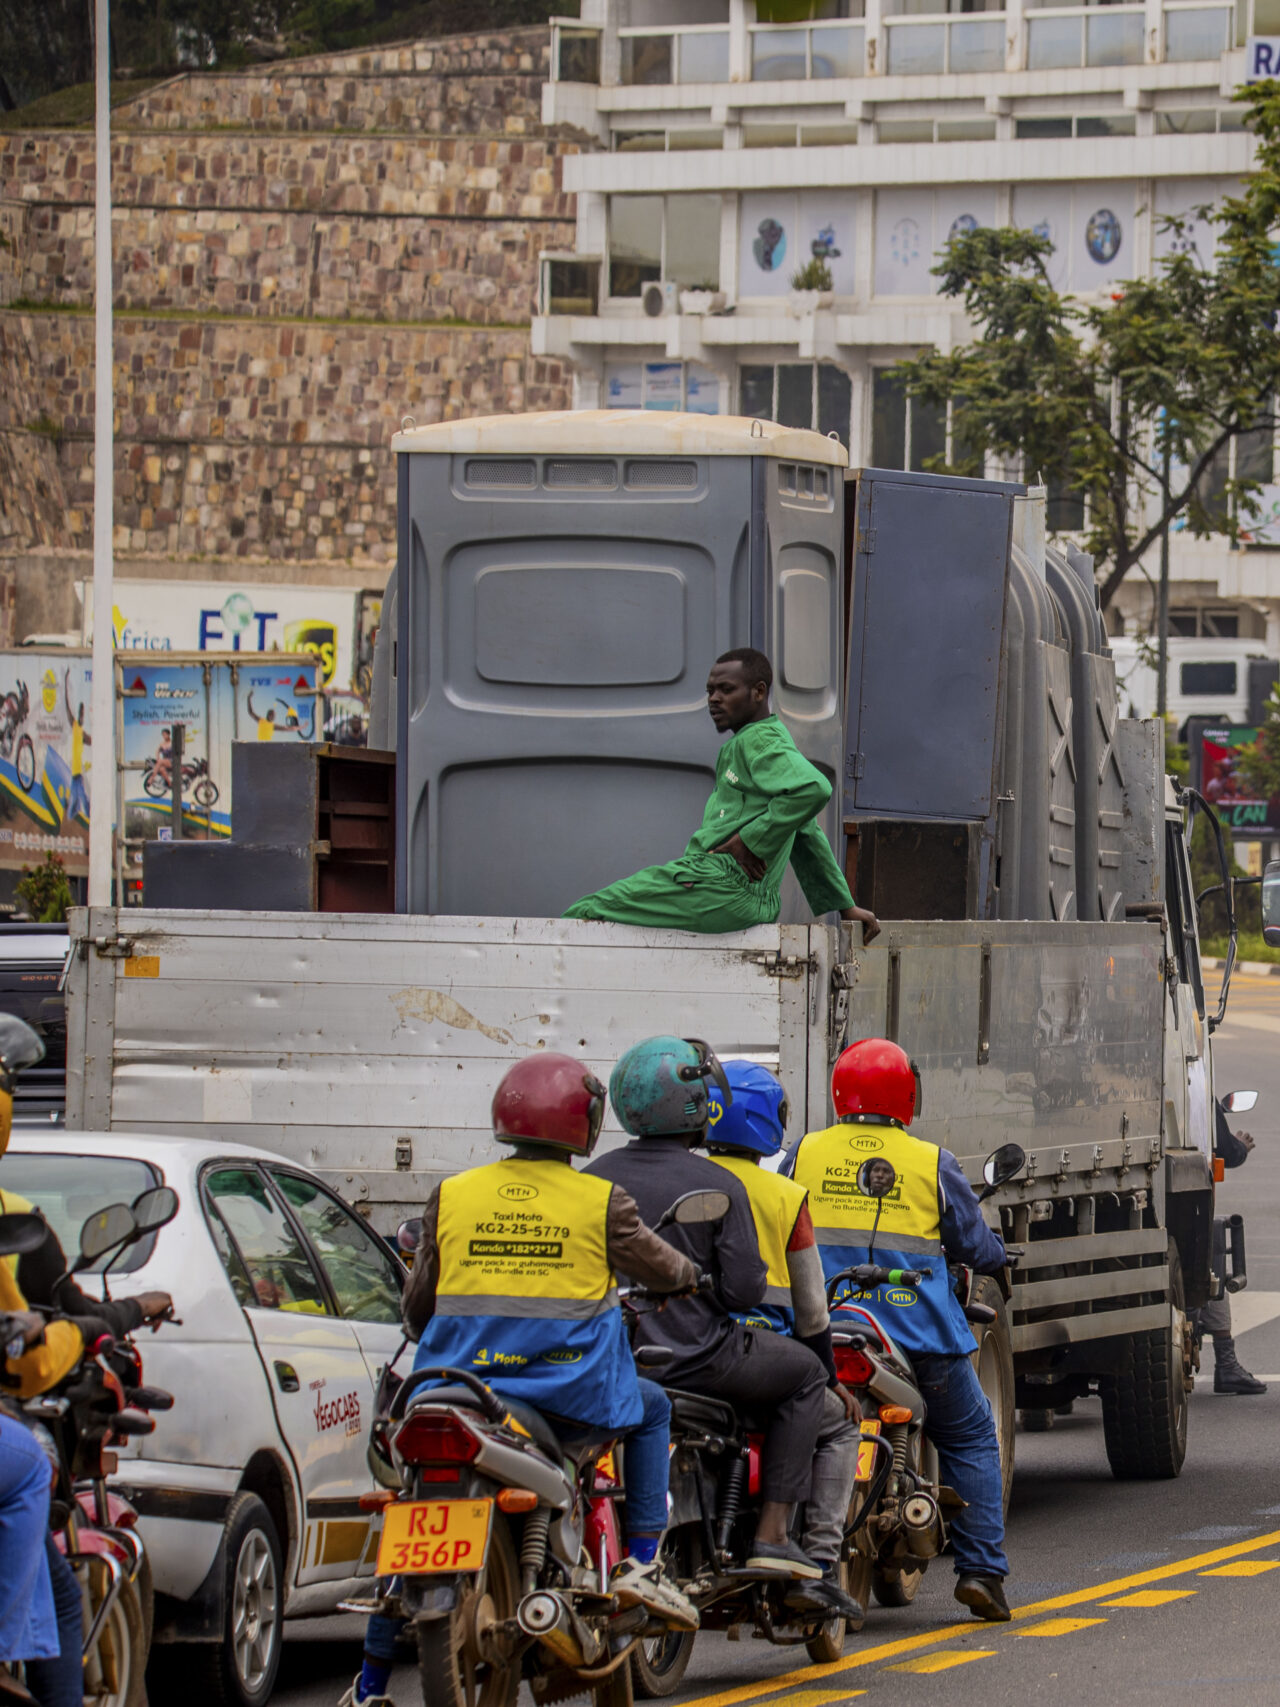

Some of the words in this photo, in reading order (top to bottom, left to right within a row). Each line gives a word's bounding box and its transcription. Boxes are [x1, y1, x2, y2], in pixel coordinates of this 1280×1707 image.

[856, 1139, 877, 1148] MTN
[506, 1187, 530, 1197] MTN
[825, 1184, 852, 1192] Kanda
[493, 1212, 514, 1221] Taxi
[516, 1212, 543, 1222] Moto
[475, 1222, 570, 1238] KG2-25-5779
[472, 1243, 504, 1253] Kanda
[892, 1292, 912, 1302] MTN
[494, 1352, 528, 1365] MoMo
[408, 1506, 449, 1537] RJ
[390, 1541, 471, 1569] 356P
